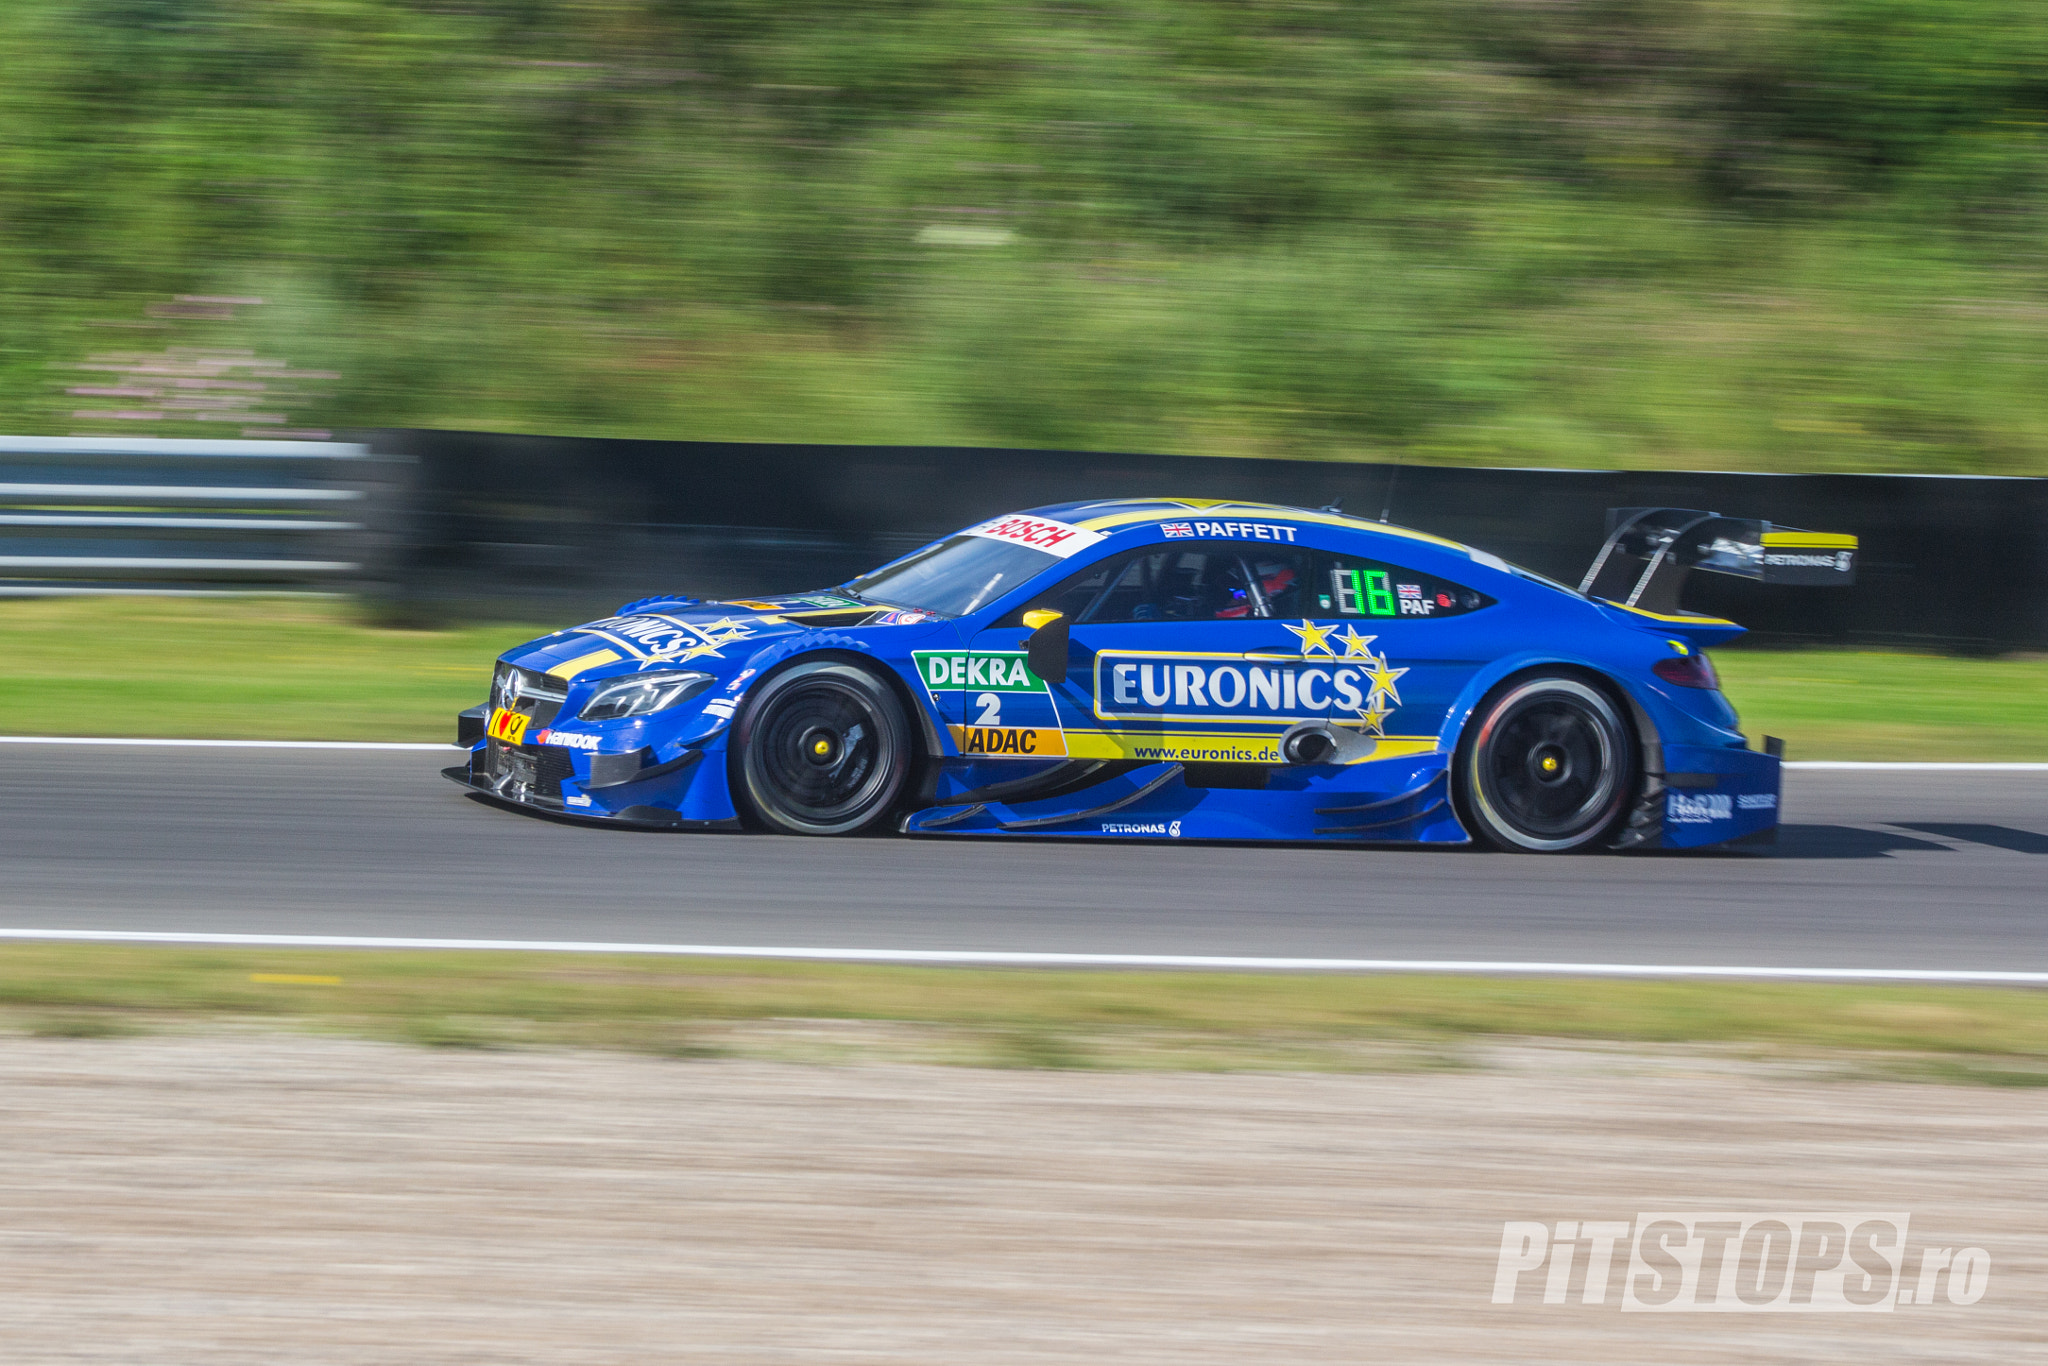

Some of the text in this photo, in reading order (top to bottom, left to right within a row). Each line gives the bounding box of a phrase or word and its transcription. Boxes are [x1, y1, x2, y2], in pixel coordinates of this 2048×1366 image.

[985, 519, 1077, 548] BOSCH
[1194, 522, 1297, 542] PAFFETT
[1400, 599, 1435, 615] PAF
[929, 657, 1031, 687] DEKRA
[1113, 663, 1363, 711] EURONICS
[974, 692, 1001, 725] 2
[968, 728, 1037, 754] ADAC
[1134, 745, 1279, 761] www.euronics.de
[1101, 823, 1166, 834] PETRONAS
